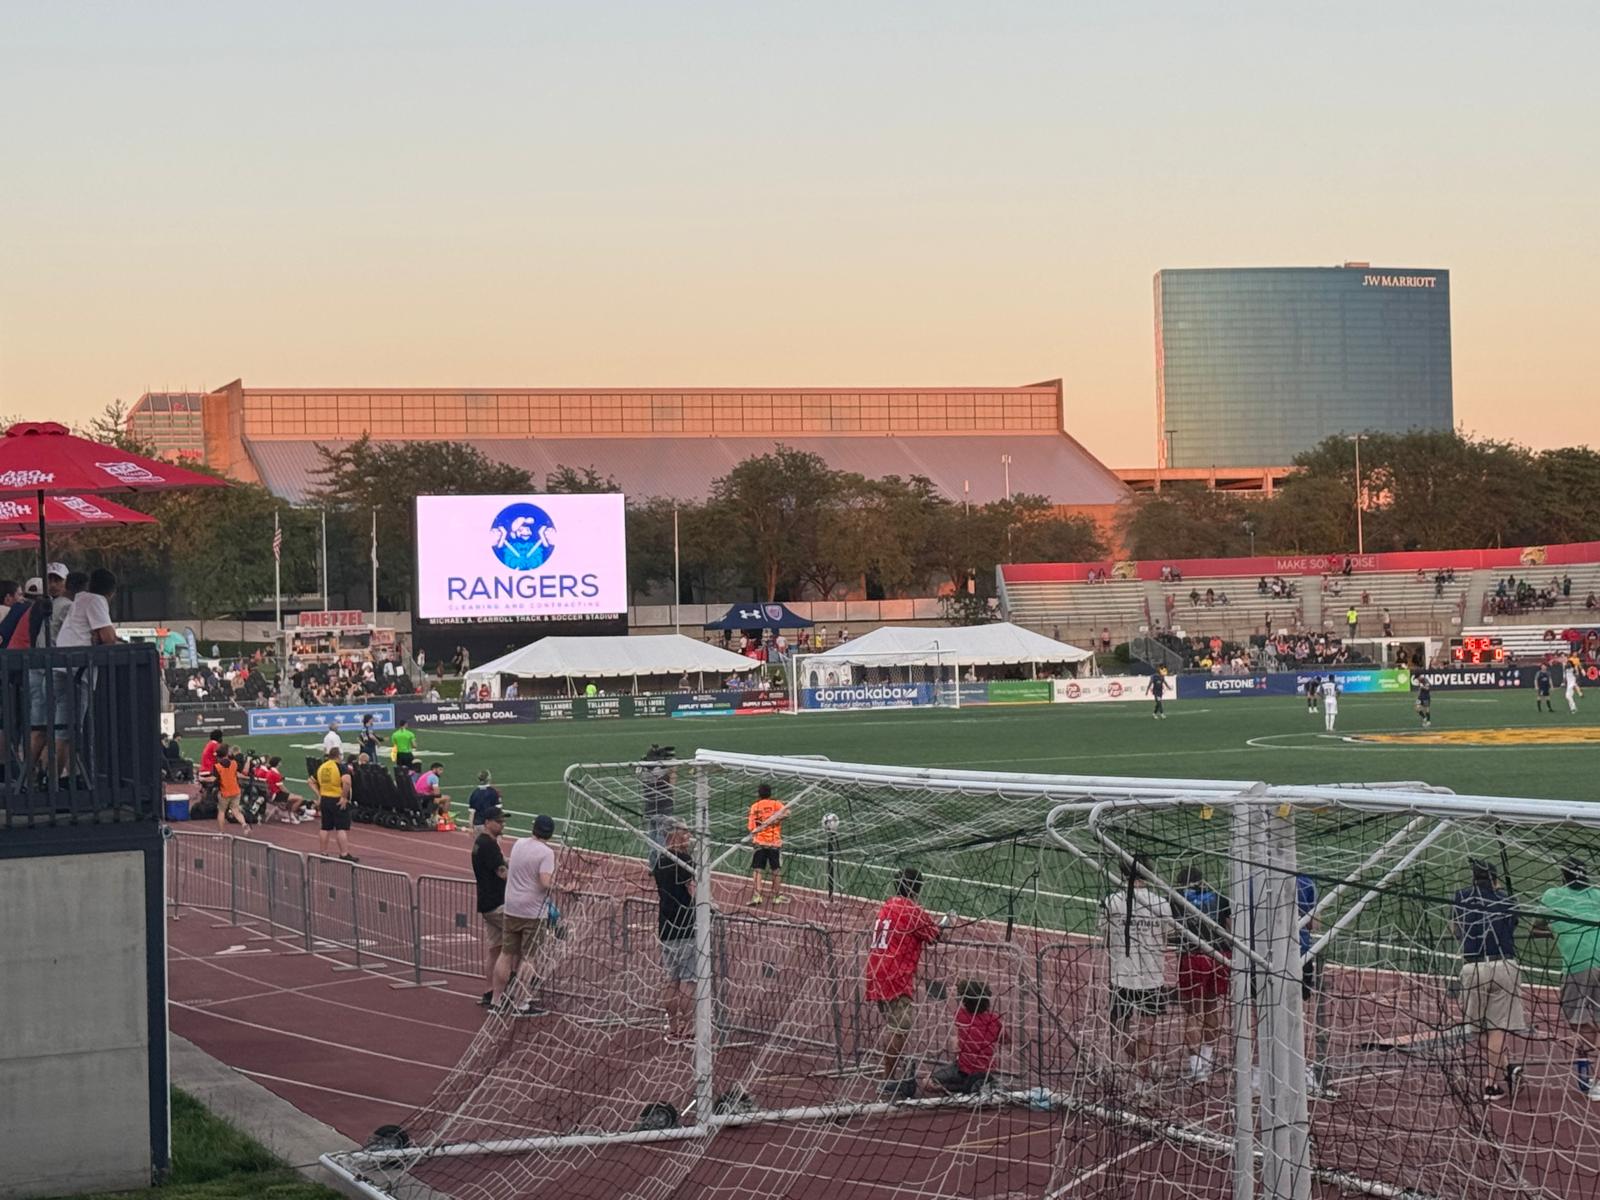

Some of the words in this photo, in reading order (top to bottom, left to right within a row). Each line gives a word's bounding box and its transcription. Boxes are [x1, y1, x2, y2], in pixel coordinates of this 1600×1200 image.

[1362, 275, 1380, 286] JW
[1381, 276, 1436, 288] MARRIOTT
[1277, 559, 1307, 570] MAKE
[447, 574, 599, 601] RANGERS
[529, 601, 600, 609] CONTRACTING
[300, 611, 364, 627] PRETZEL
[429, 617, 464, 625] MICHAEL
[1455, 648, 1464, 660] 4
[1472, 652, 1480, 663] 2
[1495, 648, 1502, 660] 0
[1205, 678, 1254, 690] KEYSTONE
[815, 687, 902, 702] dormakaba
[540, 702, 573, 711] TULLAMORE
[587, 700, 619, 709] TULLAMORE
[414, 714, 438, 723] YOUR
[439, 712, 471, 721] BRAND.
[472, 711, 491, 720] OUR
[492, 710, 518, 719] GOAL.
[870, 918, 892, 950] 11
